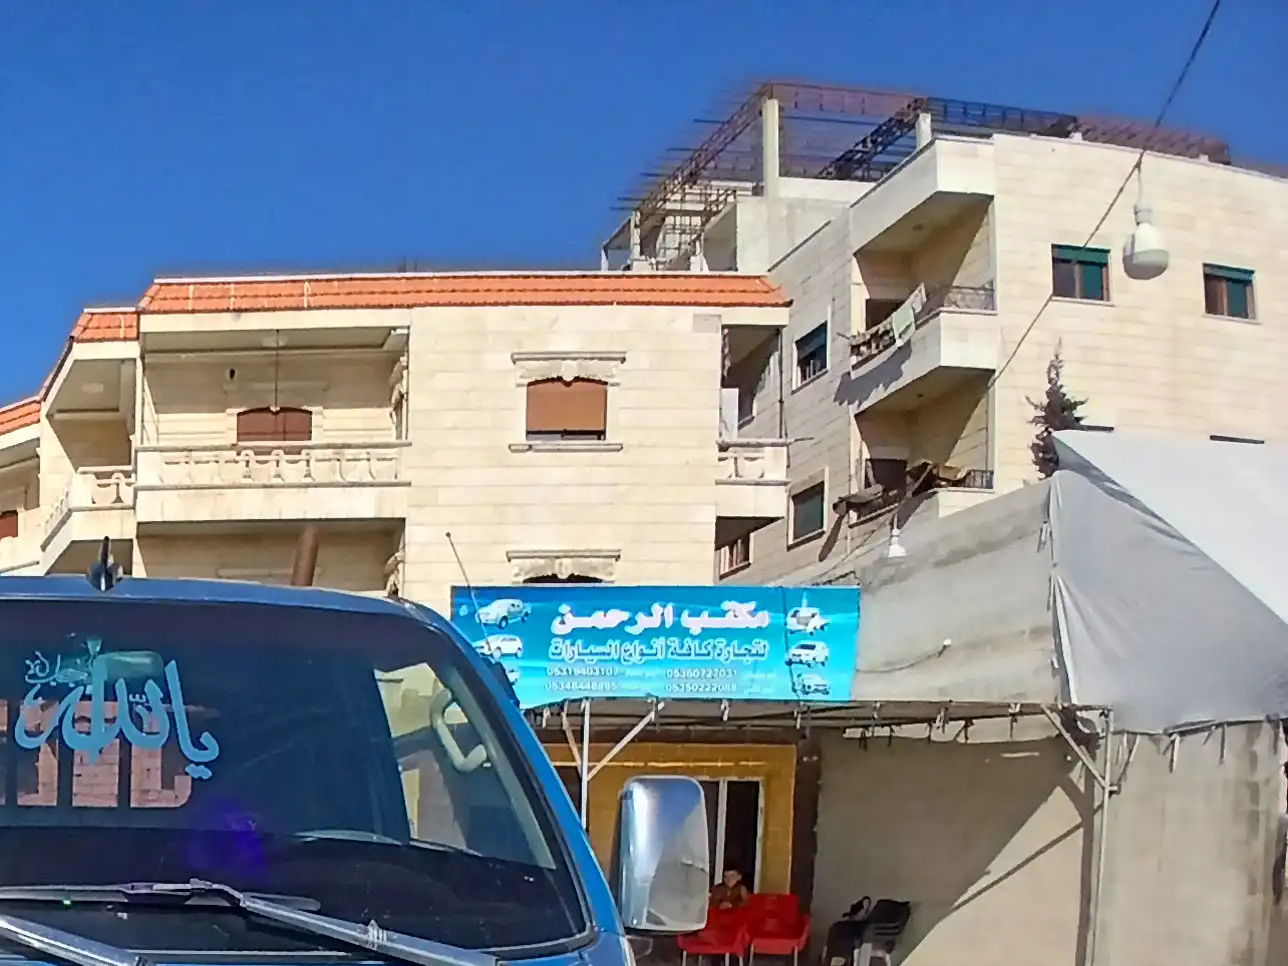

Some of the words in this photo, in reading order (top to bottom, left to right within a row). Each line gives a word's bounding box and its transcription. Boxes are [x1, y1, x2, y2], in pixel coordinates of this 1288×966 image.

[551, 602, 674, 635] الرحمن
[680, 601, 770, 635] مكتب
[549, 637, 620, 662] السيارات
[621, 636, 667, 663] أنواع
[667, 637, 714, 660] كافة
[715, 638, 770, 662] لتجارة
